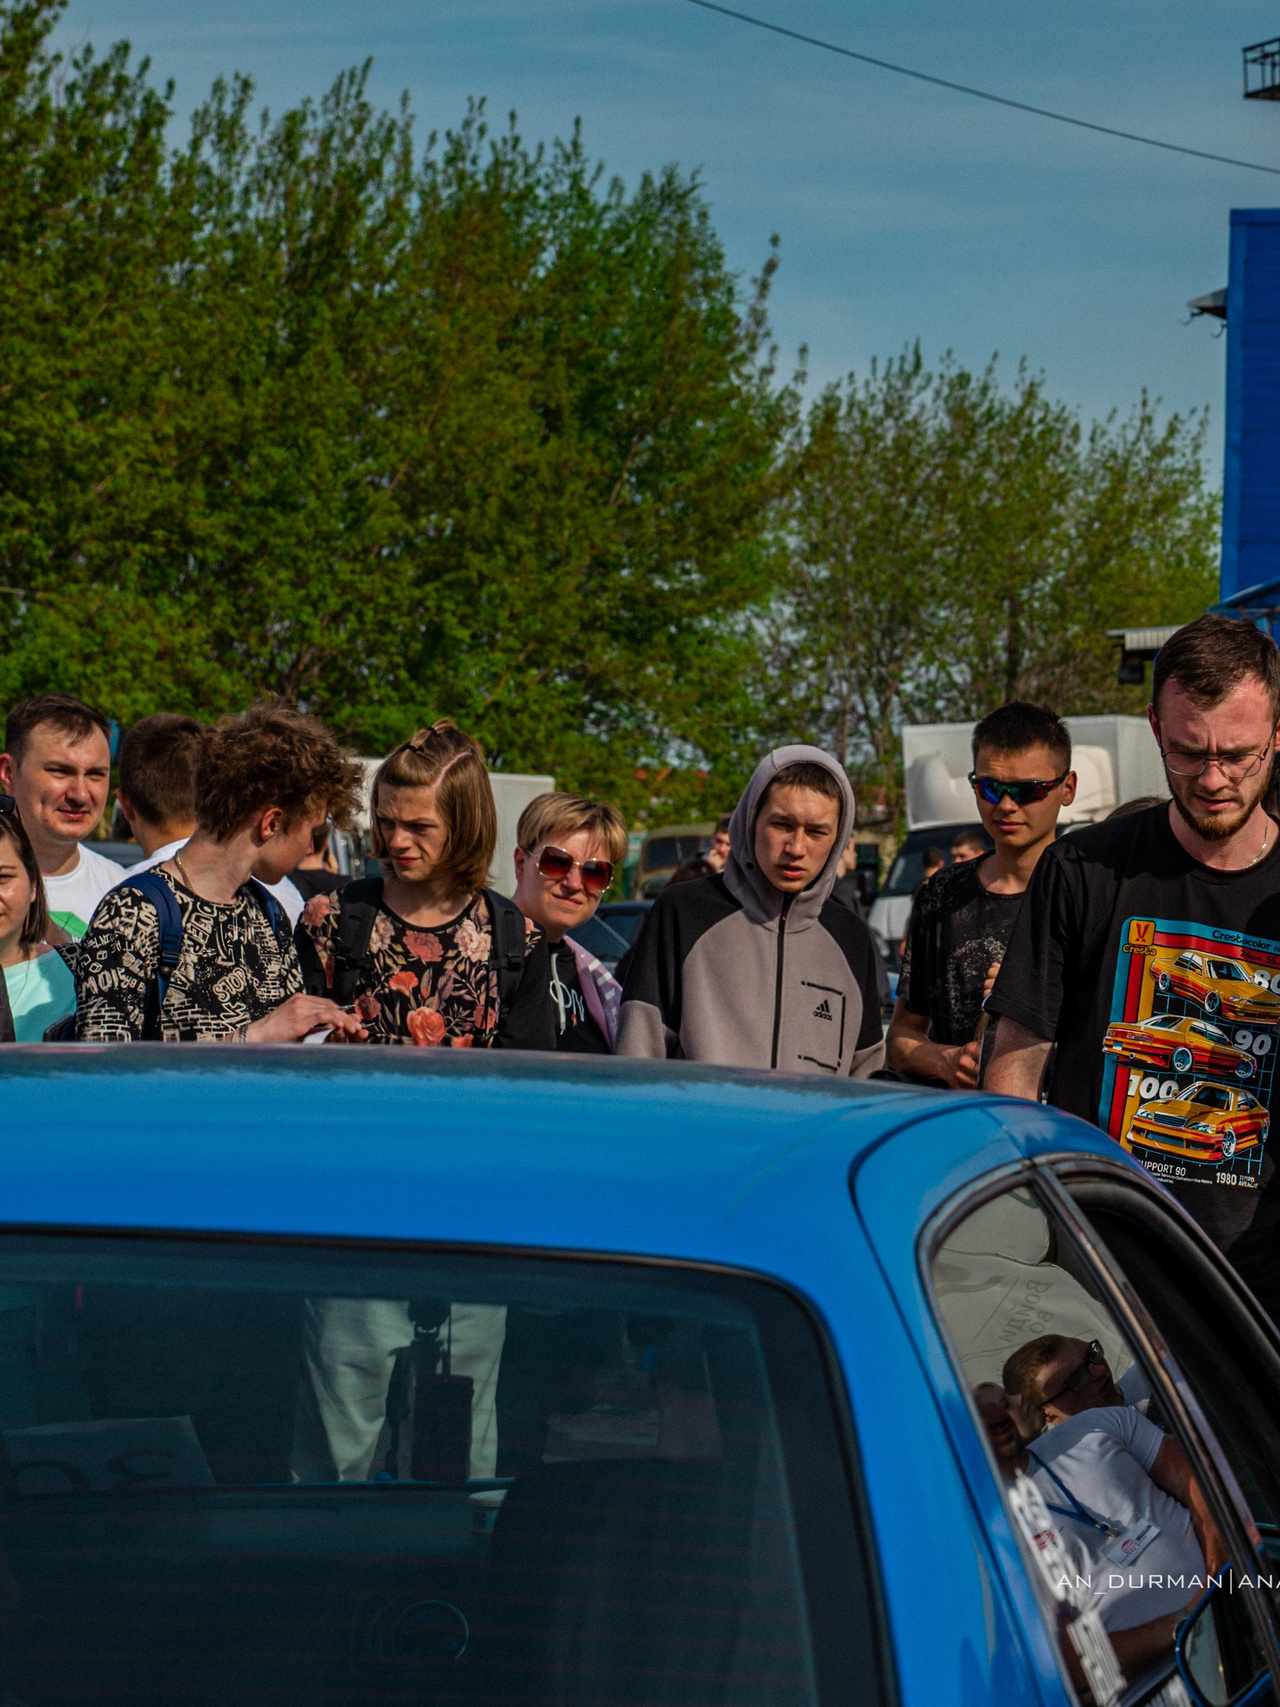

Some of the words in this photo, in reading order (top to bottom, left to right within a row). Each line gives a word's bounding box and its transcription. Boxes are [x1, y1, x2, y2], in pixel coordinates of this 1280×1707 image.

[1212, 930, 1272, 950] Crestacolor
[1122, 944, 1158, 957] Cresta
[213, 967, 247, 1003] STOP
[813, 1010, 833, 1021] adidas
[1233, 1029, 1272, 1056] 90
[1127, 1074, 1181, 1099] 100
[1174, 1166, 1187, 1177] 90
[1215, 1172, 1238, 1186] 1980
